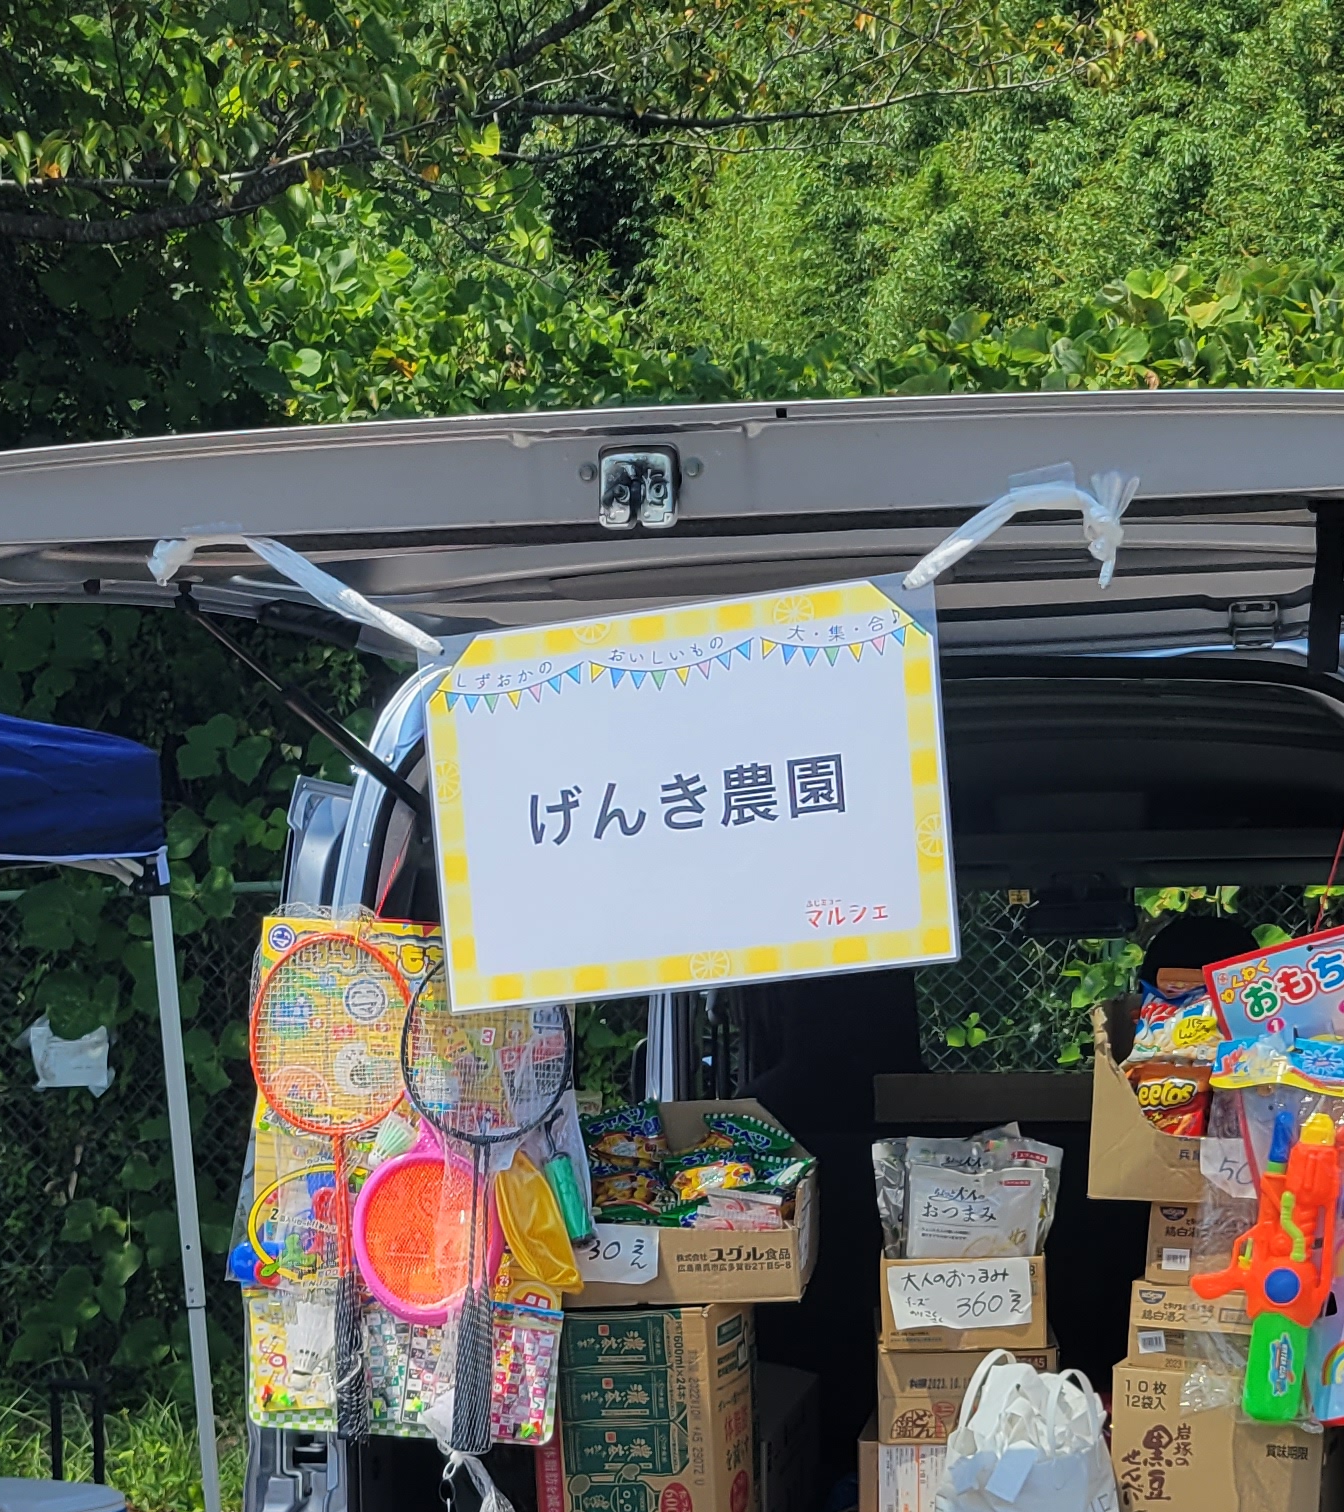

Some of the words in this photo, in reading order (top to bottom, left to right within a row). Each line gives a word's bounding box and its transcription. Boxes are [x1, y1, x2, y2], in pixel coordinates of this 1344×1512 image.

[607, 635, 725, 666] おいしいもの
[455, 660, 554, 690] しずおかの
[528, 752, 847, 847] げんき農園
[804, 903, 890, 929] マルシェ
[1137, 1080, 1198, 1108] eetos
[921, 1202, 997, 1222] おつまみ
[901, 1267, 1010, 1292] 大人のおつまみ
[1125, 1379, 1167, 1396] 10枚
[1125, 1394, 1167, 1411] 12袋入
[1173, 1422, 1194, 1467] 岩塚の
[1265, 1444, 1309, 1460] 賞味期限
[1142, 1424, 1174, 1501] 黒豆
